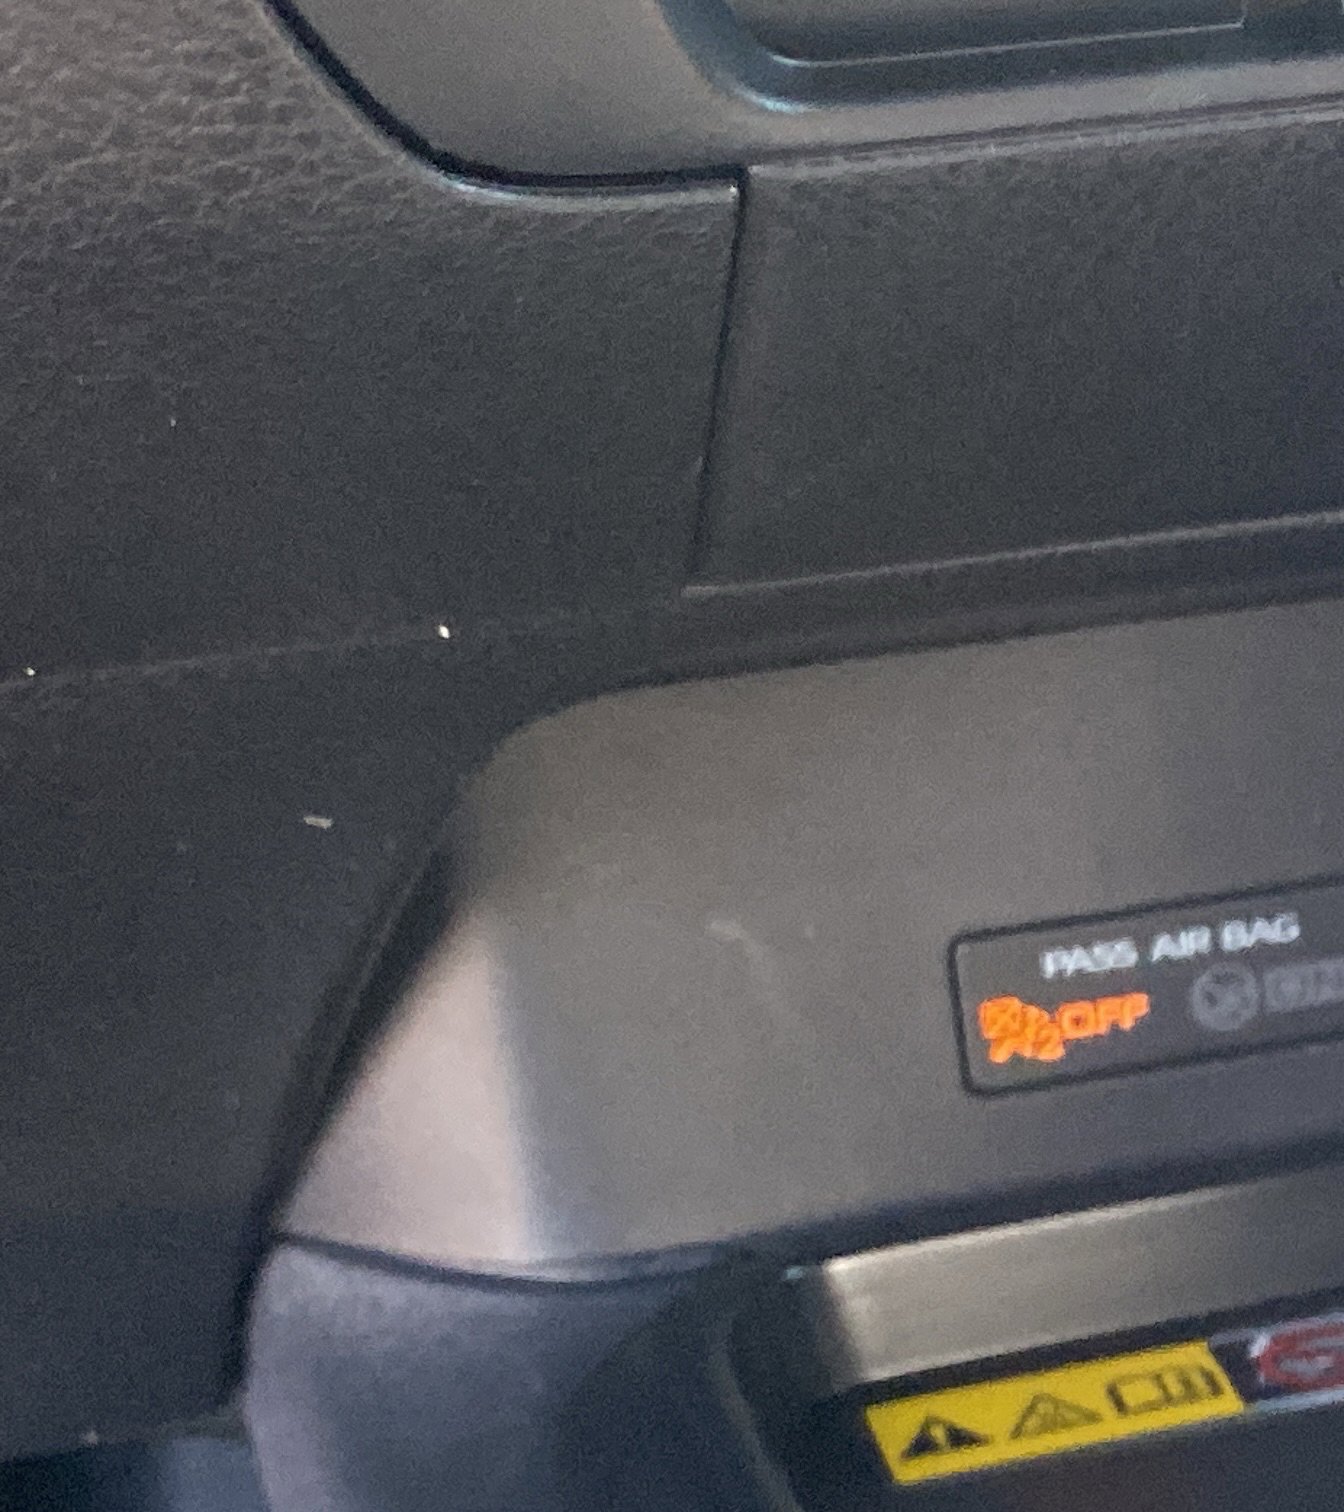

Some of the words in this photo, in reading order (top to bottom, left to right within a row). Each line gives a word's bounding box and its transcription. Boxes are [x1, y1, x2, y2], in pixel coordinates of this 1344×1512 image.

[1040, 937, 1139, 978] PASS
[1151, 926, 1212, 962] AIR
[1220, 912, 1300, 951] BAG
[1060, 992, 1150, 1040] OFF
